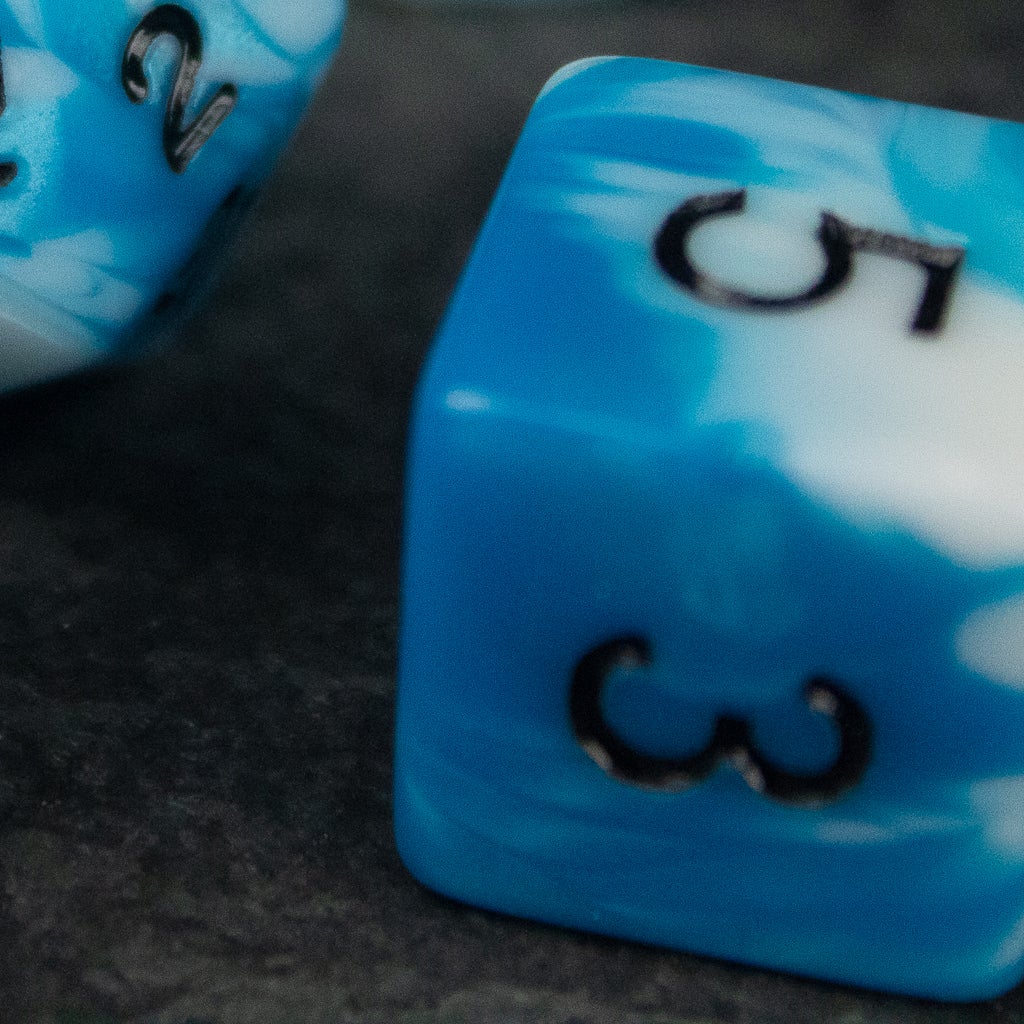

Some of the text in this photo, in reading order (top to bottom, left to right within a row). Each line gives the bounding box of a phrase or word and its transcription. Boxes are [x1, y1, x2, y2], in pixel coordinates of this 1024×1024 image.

[121, 3, 238, 174] 2
[652, 189, 970, 340] 5
[567, 631, 876, 808] 3
